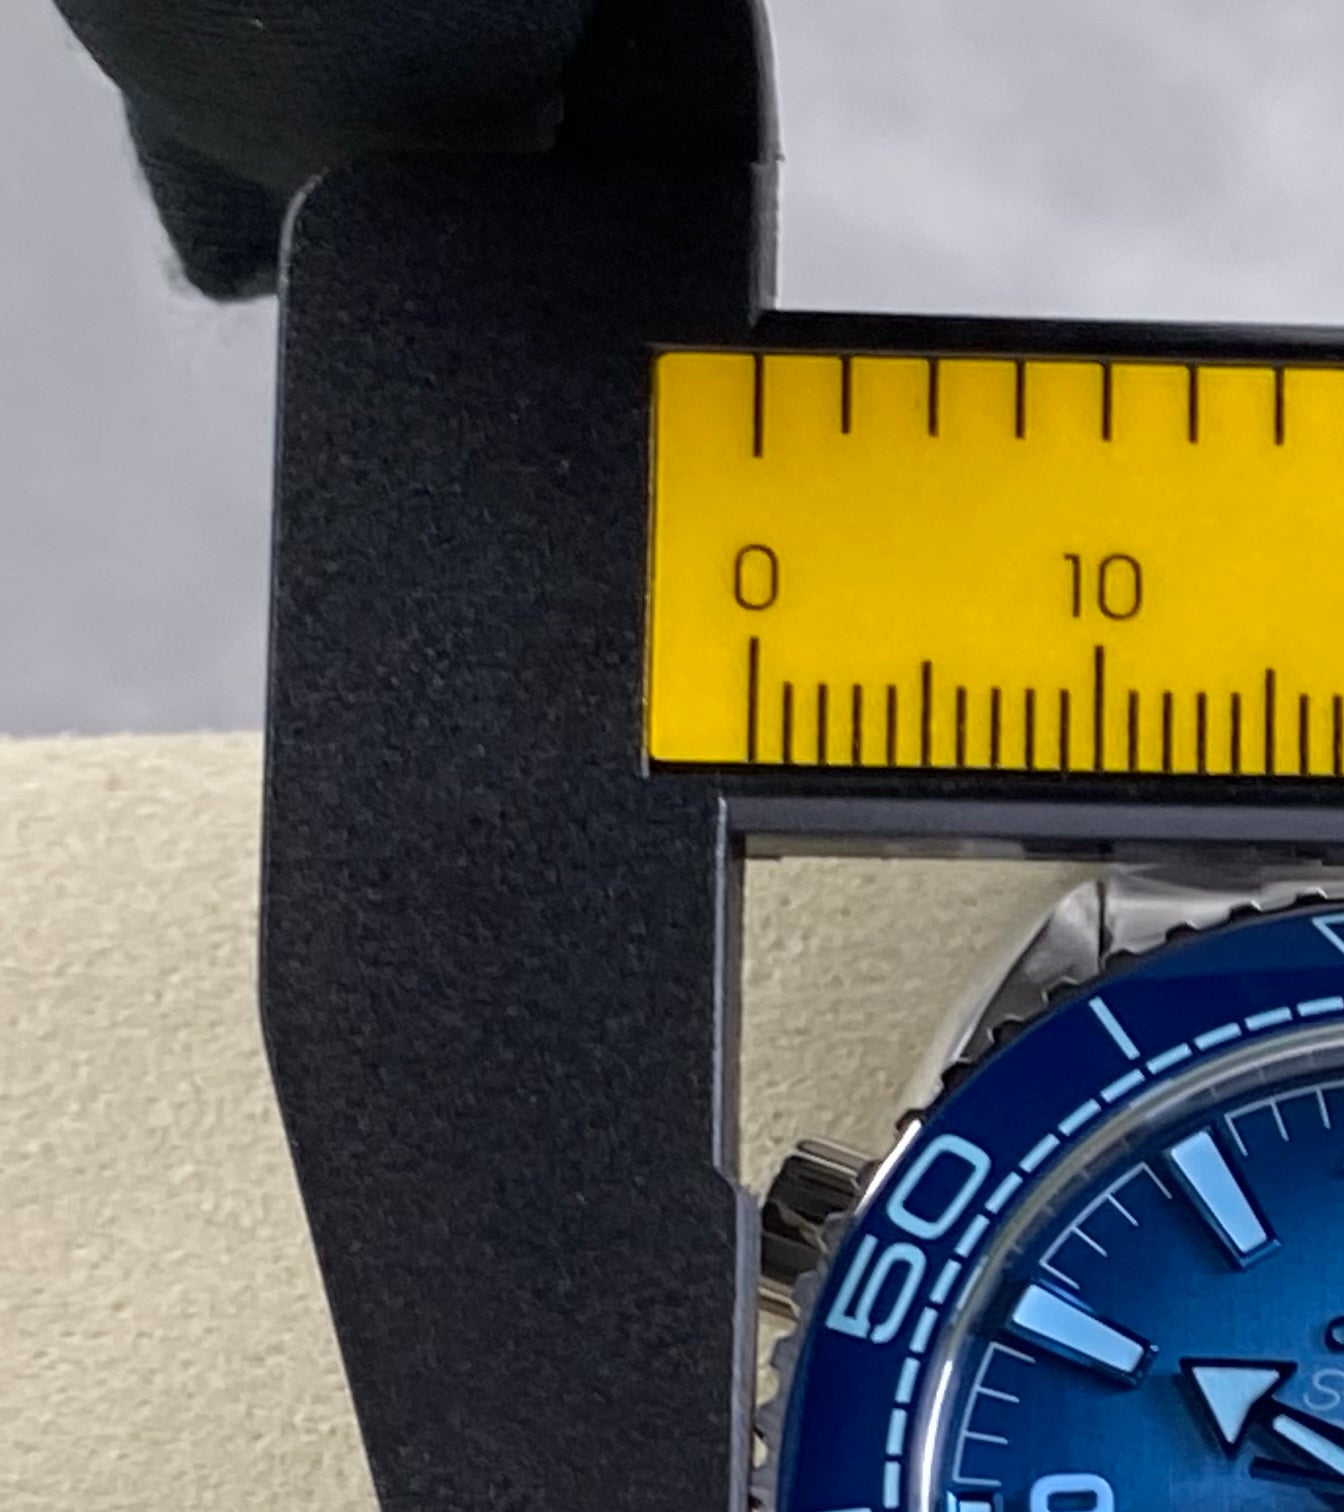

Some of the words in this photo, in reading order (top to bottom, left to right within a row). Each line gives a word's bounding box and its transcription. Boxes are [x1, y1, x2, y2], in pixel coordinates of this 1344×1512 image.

[733, 543, 780, 612] 0
[1063, 552, 1143, 621] 10
[825, 1133, 992, 1344] 50
